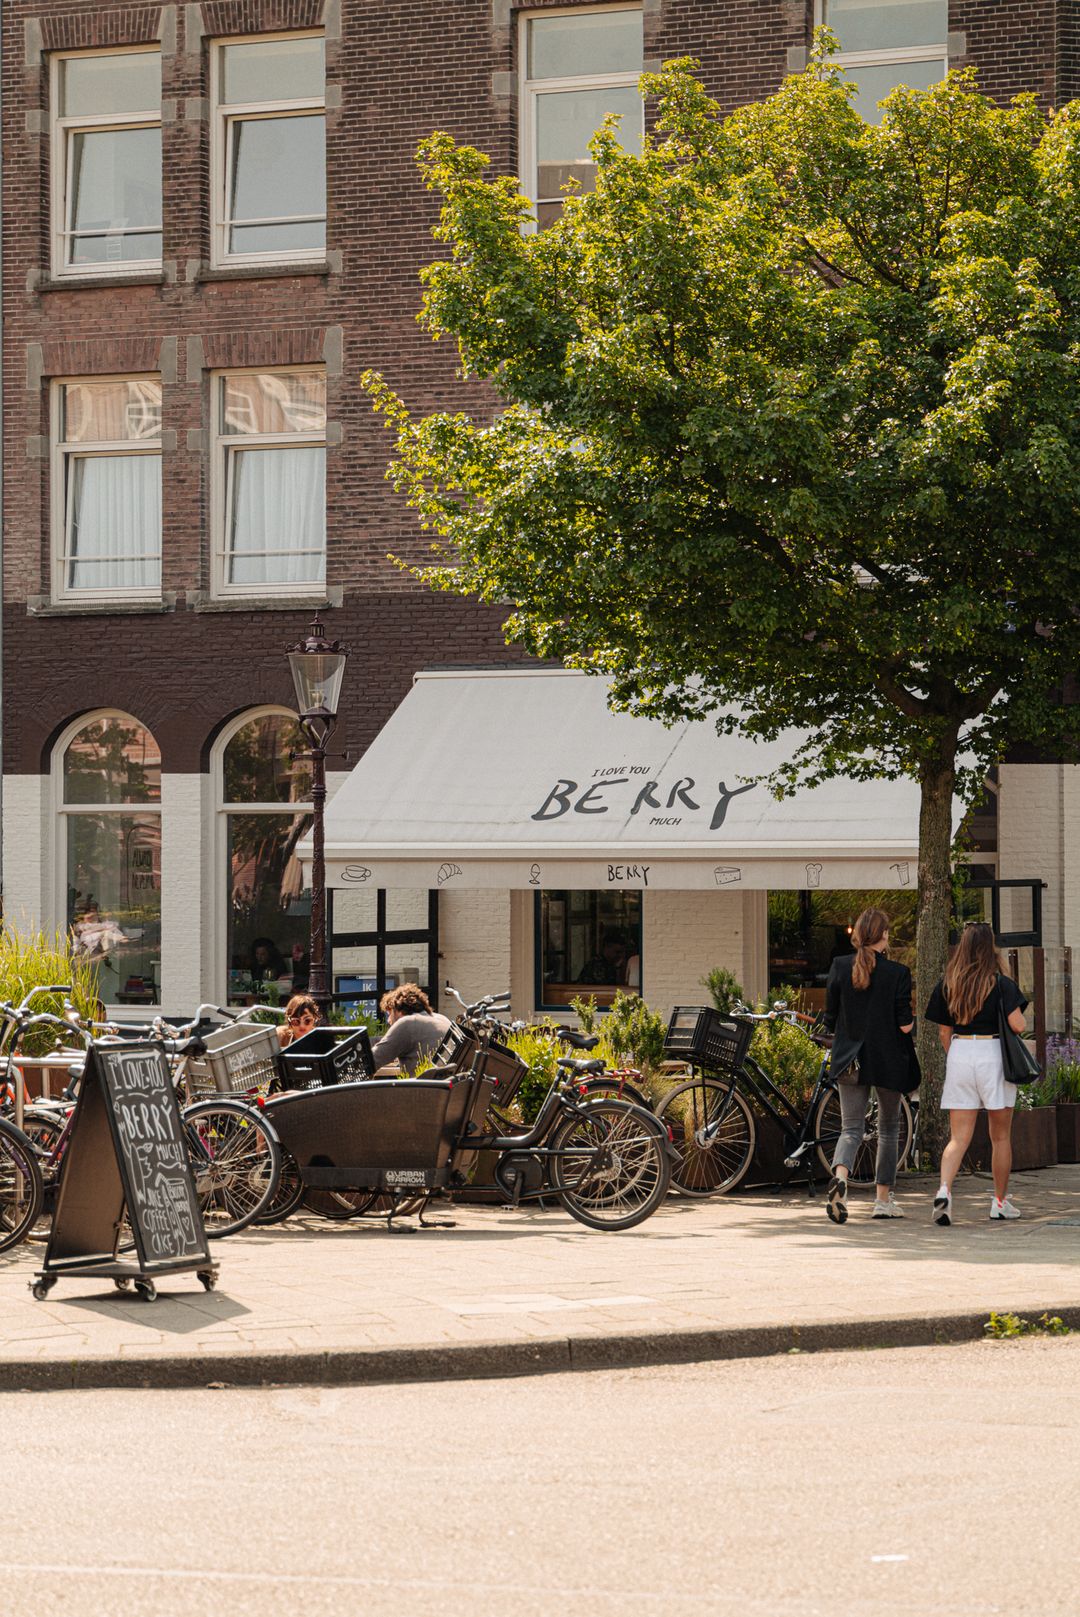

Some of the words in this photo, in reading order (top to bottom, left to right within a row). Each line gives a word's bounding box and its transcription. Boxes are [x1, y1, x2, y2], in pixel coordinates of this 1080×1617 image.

[592, 769, 600, 777] I
[600, 767, 628, 777] LOVE
[629, 765, 651, 775] YOU
[530, 777, 758, 830] BERRY
[649, 817, 682, 826] MUCH
[607, 864, 650, 886] BERRY
[108, 1062, 122, 1090] I
[119, 1061, 149, 1089] LOVE
[145, 1059, 164, 1087] YOU
[121, 1103, 175, 1141] BERRY
[156, 1141, 185, 1161] MUCH!
